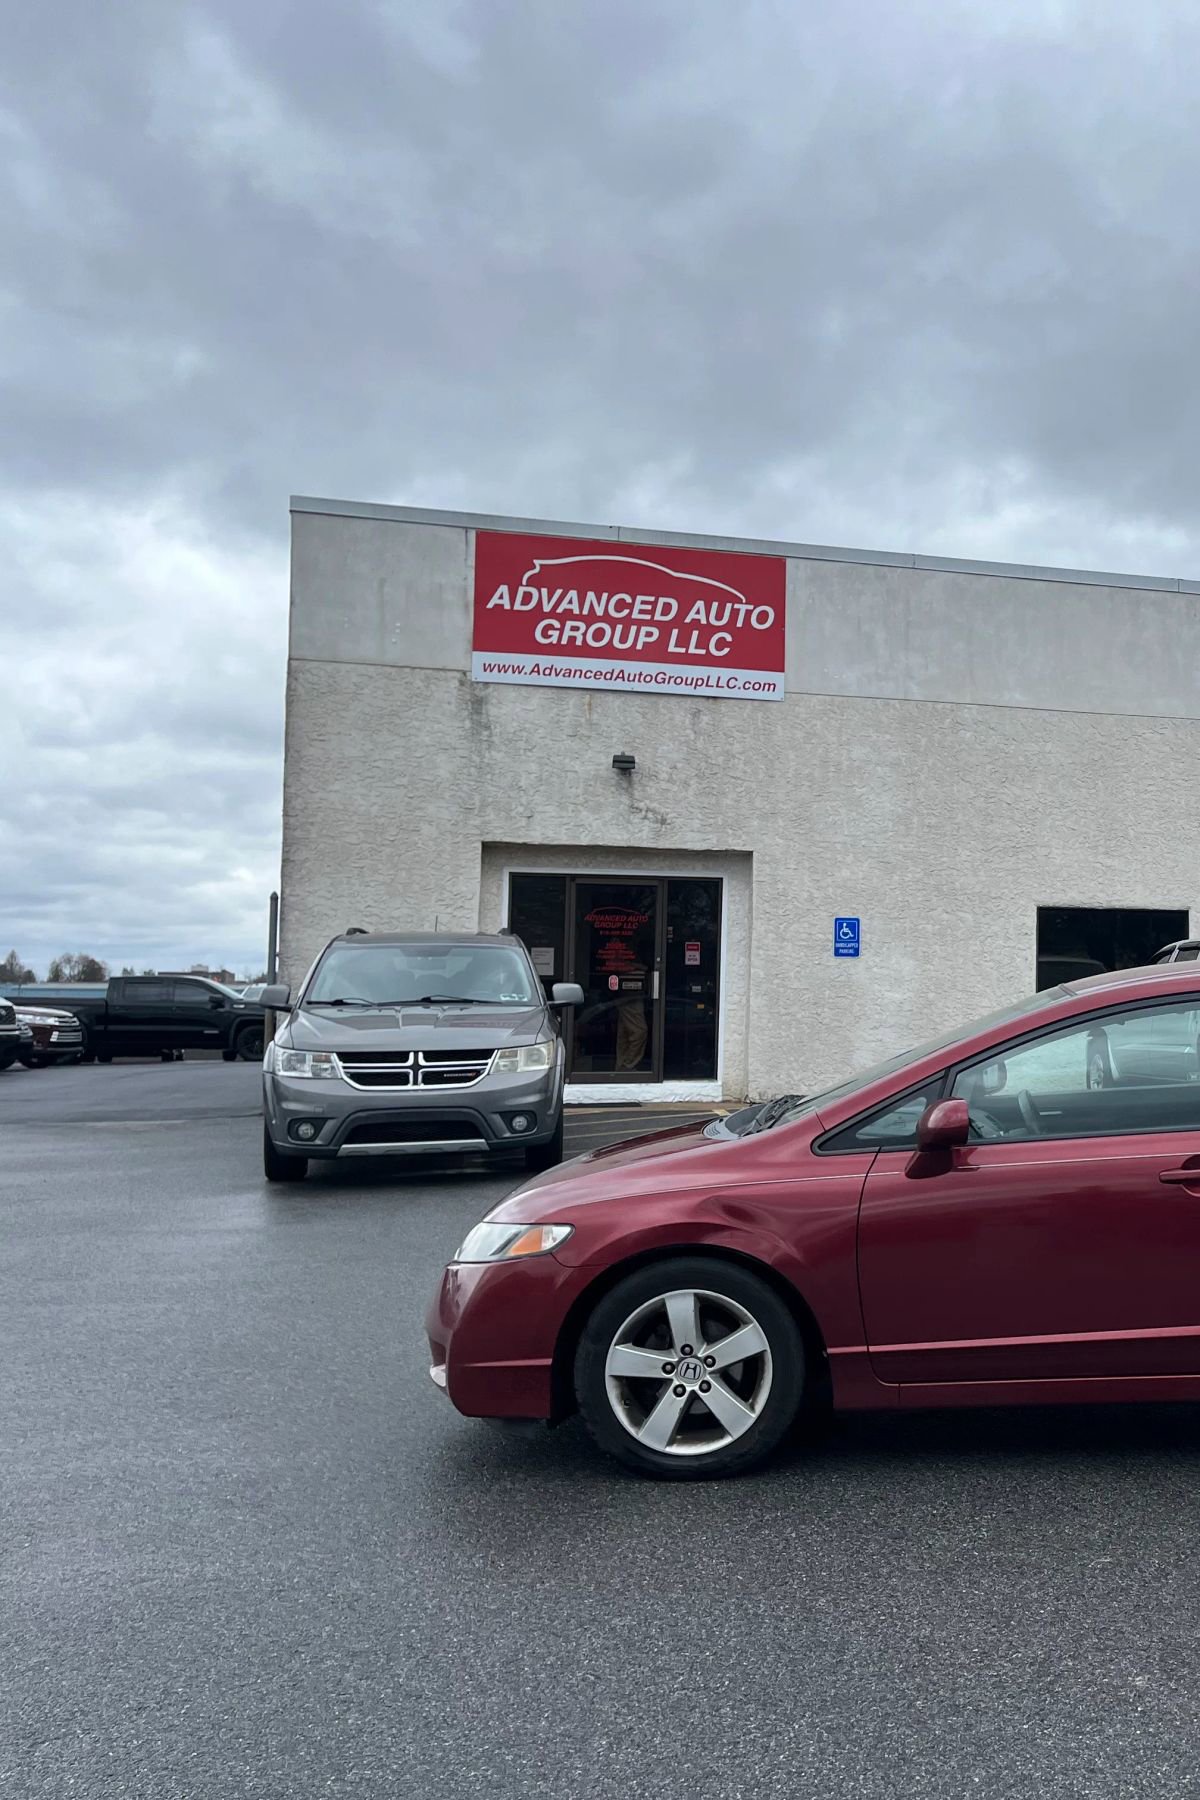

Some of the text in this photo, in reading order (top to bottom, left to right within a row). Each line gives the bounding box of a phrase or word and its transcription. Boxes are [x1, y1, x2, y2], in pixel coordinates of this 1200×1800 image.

[486, 584, 775, 630] ADVANCED AUTO
[534, 618, 733, 657] GROUP LLC
[482, 660, 777, 694] www.AdvancedAutoGroupLLC.com
